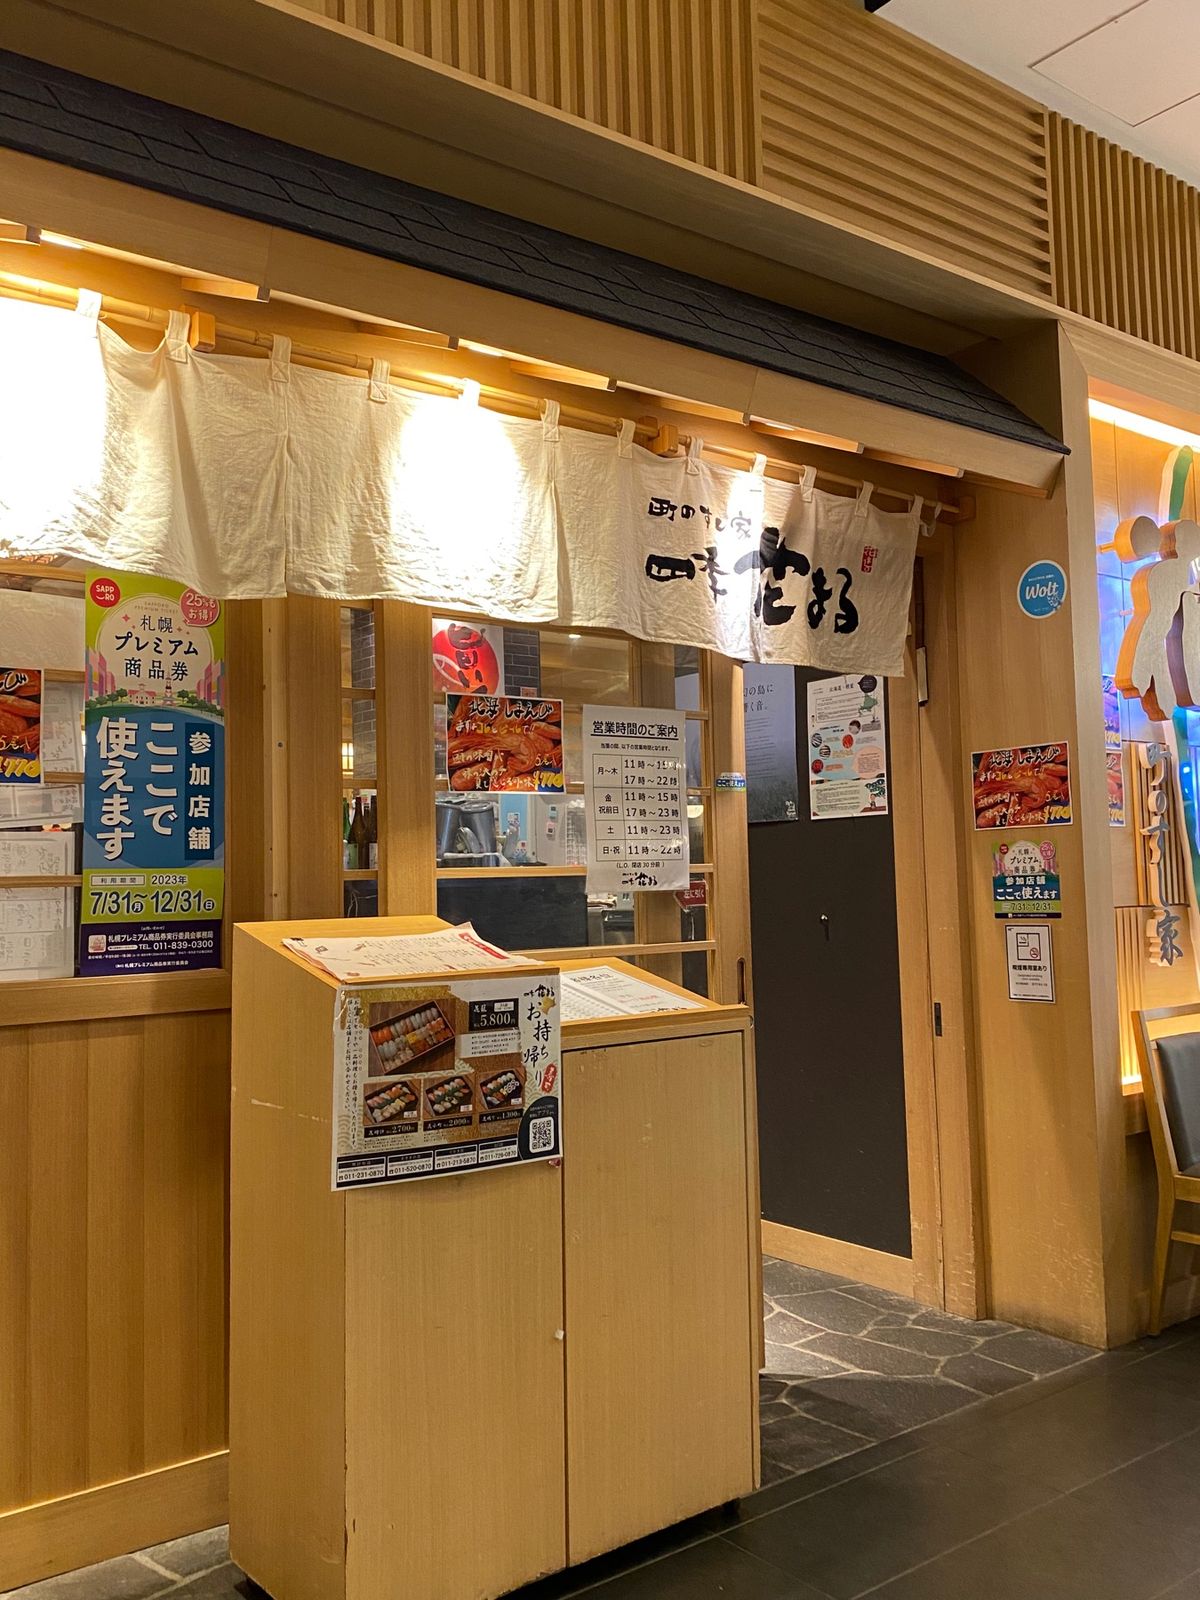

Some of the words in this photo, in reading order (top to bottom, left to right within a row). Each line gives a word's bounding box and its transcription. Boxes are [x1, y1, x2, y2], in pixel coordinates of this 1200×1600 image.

[1025, 581, 1059, 600] Wolt
[140, 614, 173, 634] 札幌
[115, 632, 198, 656] プレミアム
[124, 657, 188, 681] 商品券
[593, 721, 678, 738] 営業時間のご案内
[96, 716, 139, 860] 使えます
[143, 722, 178, 836] ここで
[188, 731, 212, 850] 参加店舗
[599, 806, 619, 814] 祝前日
[151, 875, 187, 885] 2023年
[1005, 875, 1046, 886] 参加店舗
[996, 886, 1058, 900] ここで使えます
[153, 940, 213, 950] 011-839-0300
[524, 1002, 552, 1087] お持ち帰り
